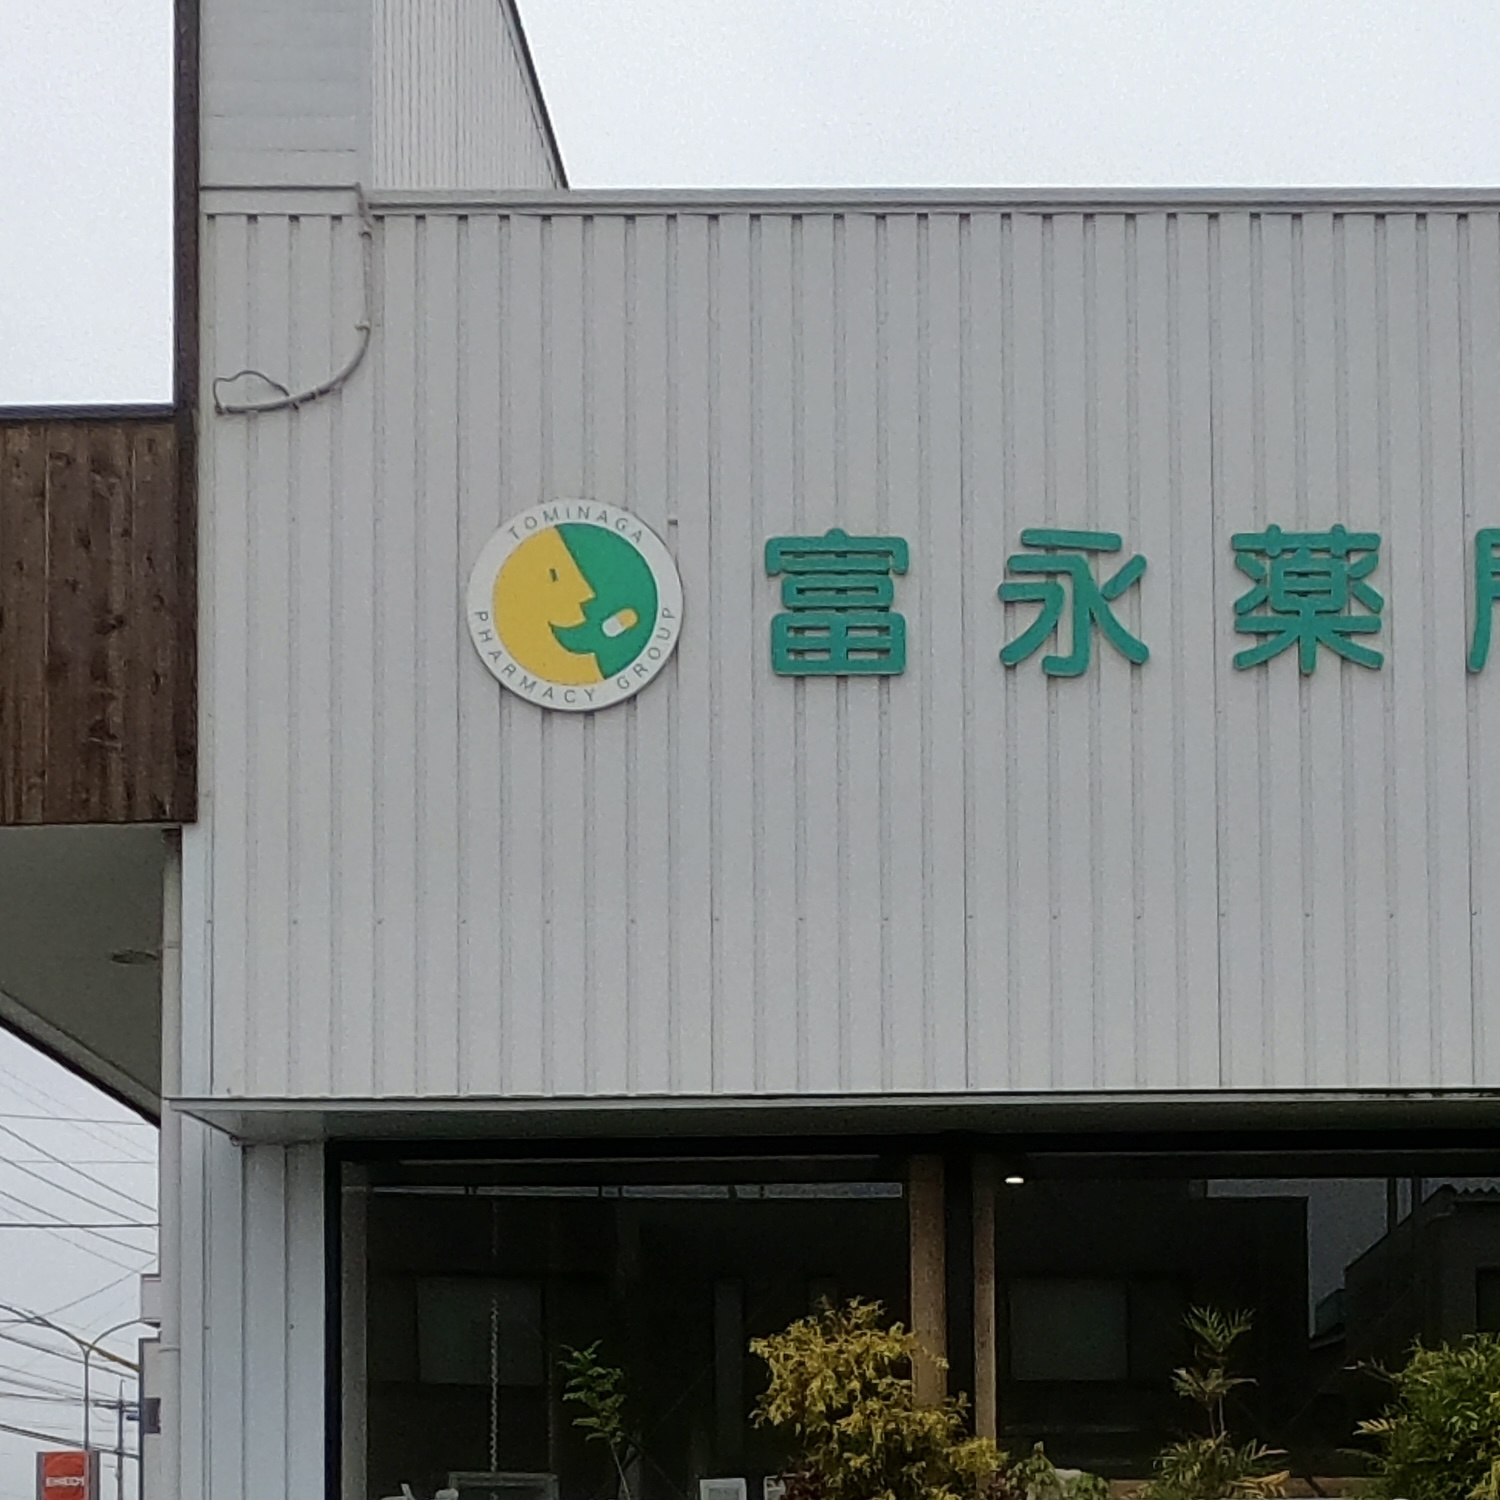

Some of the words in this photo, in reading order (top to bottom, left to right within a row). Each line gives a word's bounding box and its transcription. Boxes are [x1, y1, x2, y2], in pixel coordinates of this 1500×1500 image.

[508, 505, 643, 543] TOMINAGA
[475, 611, 596, 704] PHARMACY
[616, 608, 677, 690] GROUP
